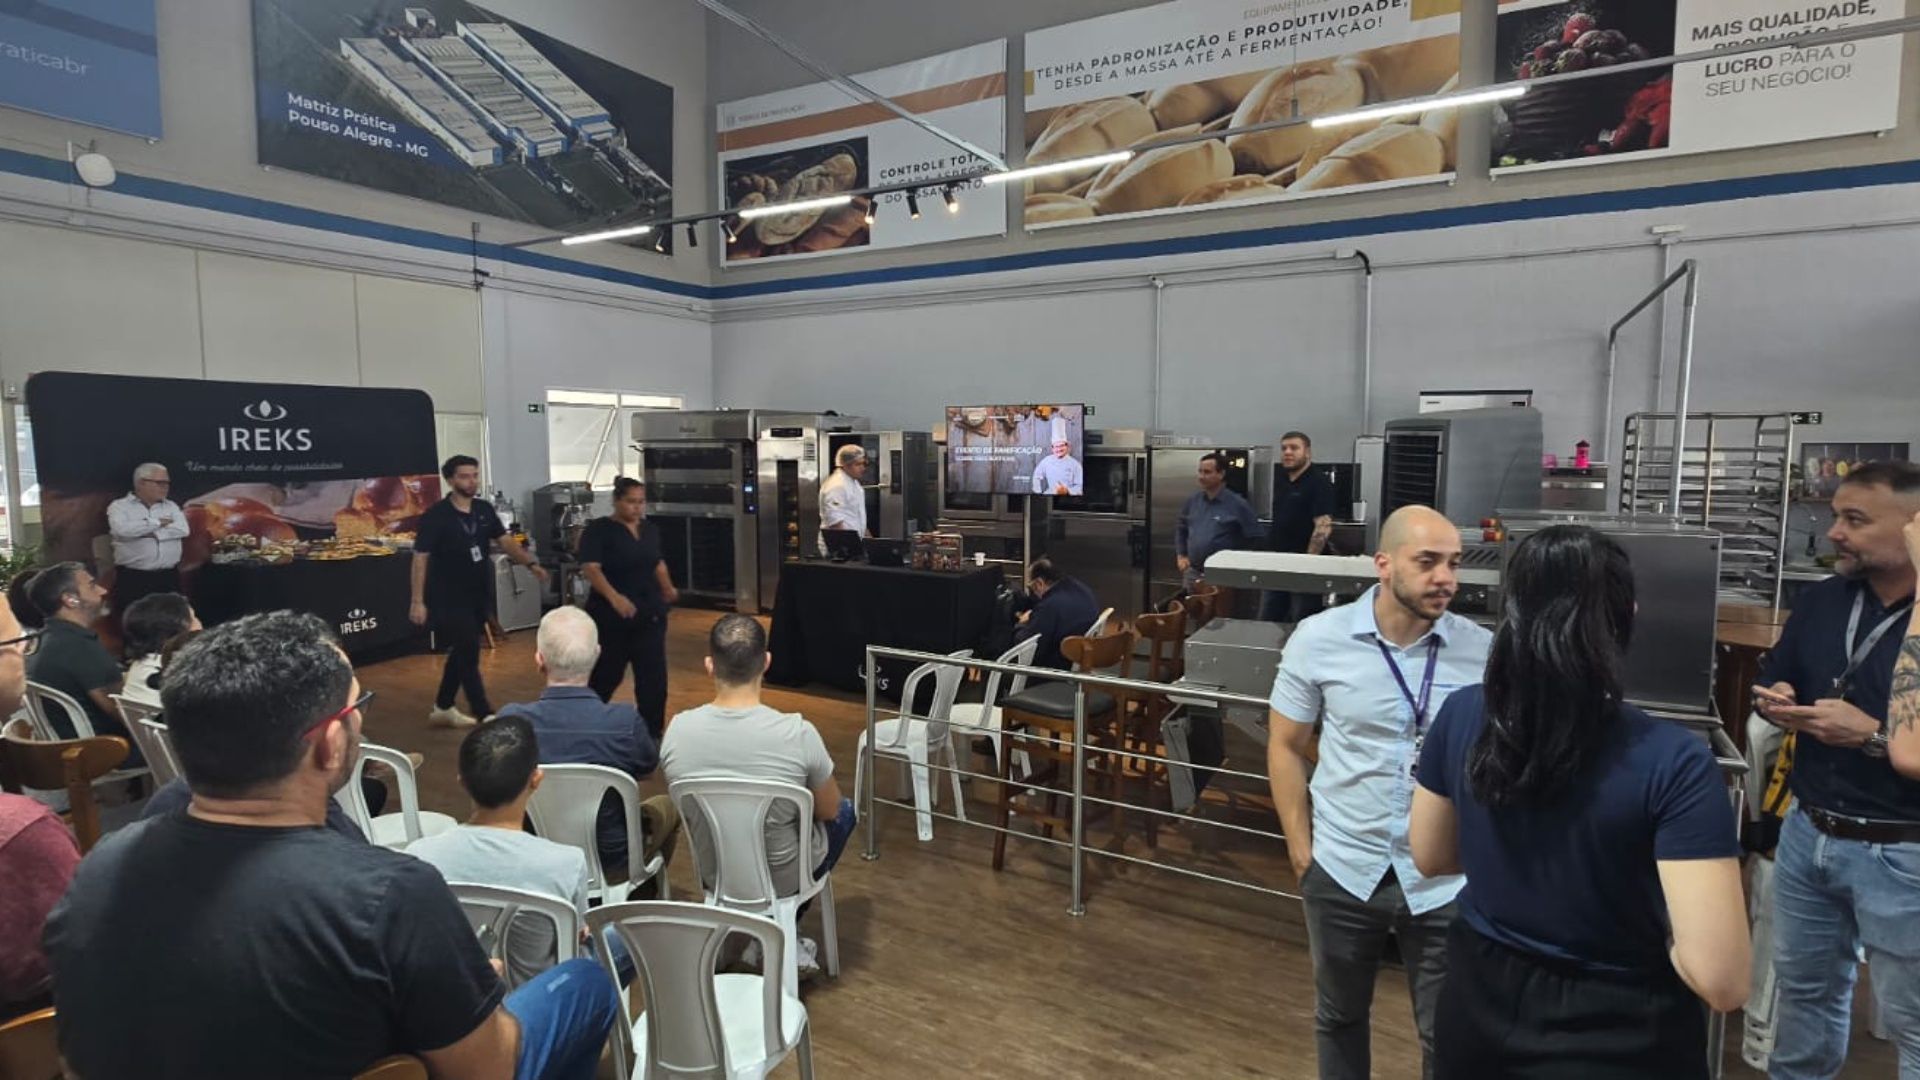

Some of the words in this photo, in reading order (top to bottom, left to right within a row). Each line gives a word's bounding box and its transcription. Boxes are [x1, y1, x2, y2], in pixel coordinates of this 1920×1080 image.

[1691, 20, 1743, 42] MAIS
[1749, 0, 1877, 33] QUALIDADE,
[1036, 61, 1085, 80] TENHA
[1091, 34, 1220, 69] PADRONIZAÇÃO
[1228, 31, 1236, 42] E
[1244, 0, 1408, 38] PRODUTIVIDADE,
[1054, 72, 1102, 90] DESDE
[1109, 69, 1119, 80] A
[1125, 57, 1178, 77] MASSA
[1184, 50, 1214, 66] ATÉ
[1221, 48, 1232, 60] A
[1239, 16, 1383, 56] FERMENTAÇÃO!
[1704, 55, 1774, 78] LUCRO
[1779, 46, 1835, 66] PARA
[1840, 43, 1856, 58] O
[1705, 79, 1746, 97] SEU
[1751, 64, 1852, 91] NEGÓCIO!
[287, 92, 340, 118] Matriz
[343, 107, 397, 133] Prática
[288, 109, 340, 134] Pouso
[343, 125, 393, 148] Alegre
[405, 141, 429, 158] MG
[880, 158, 945, 179] CONTROLE
[885, 193, 902, 204] DO
[218, 426, 313, 451] IREKS
[340, 617, 377, 635] IREKS
